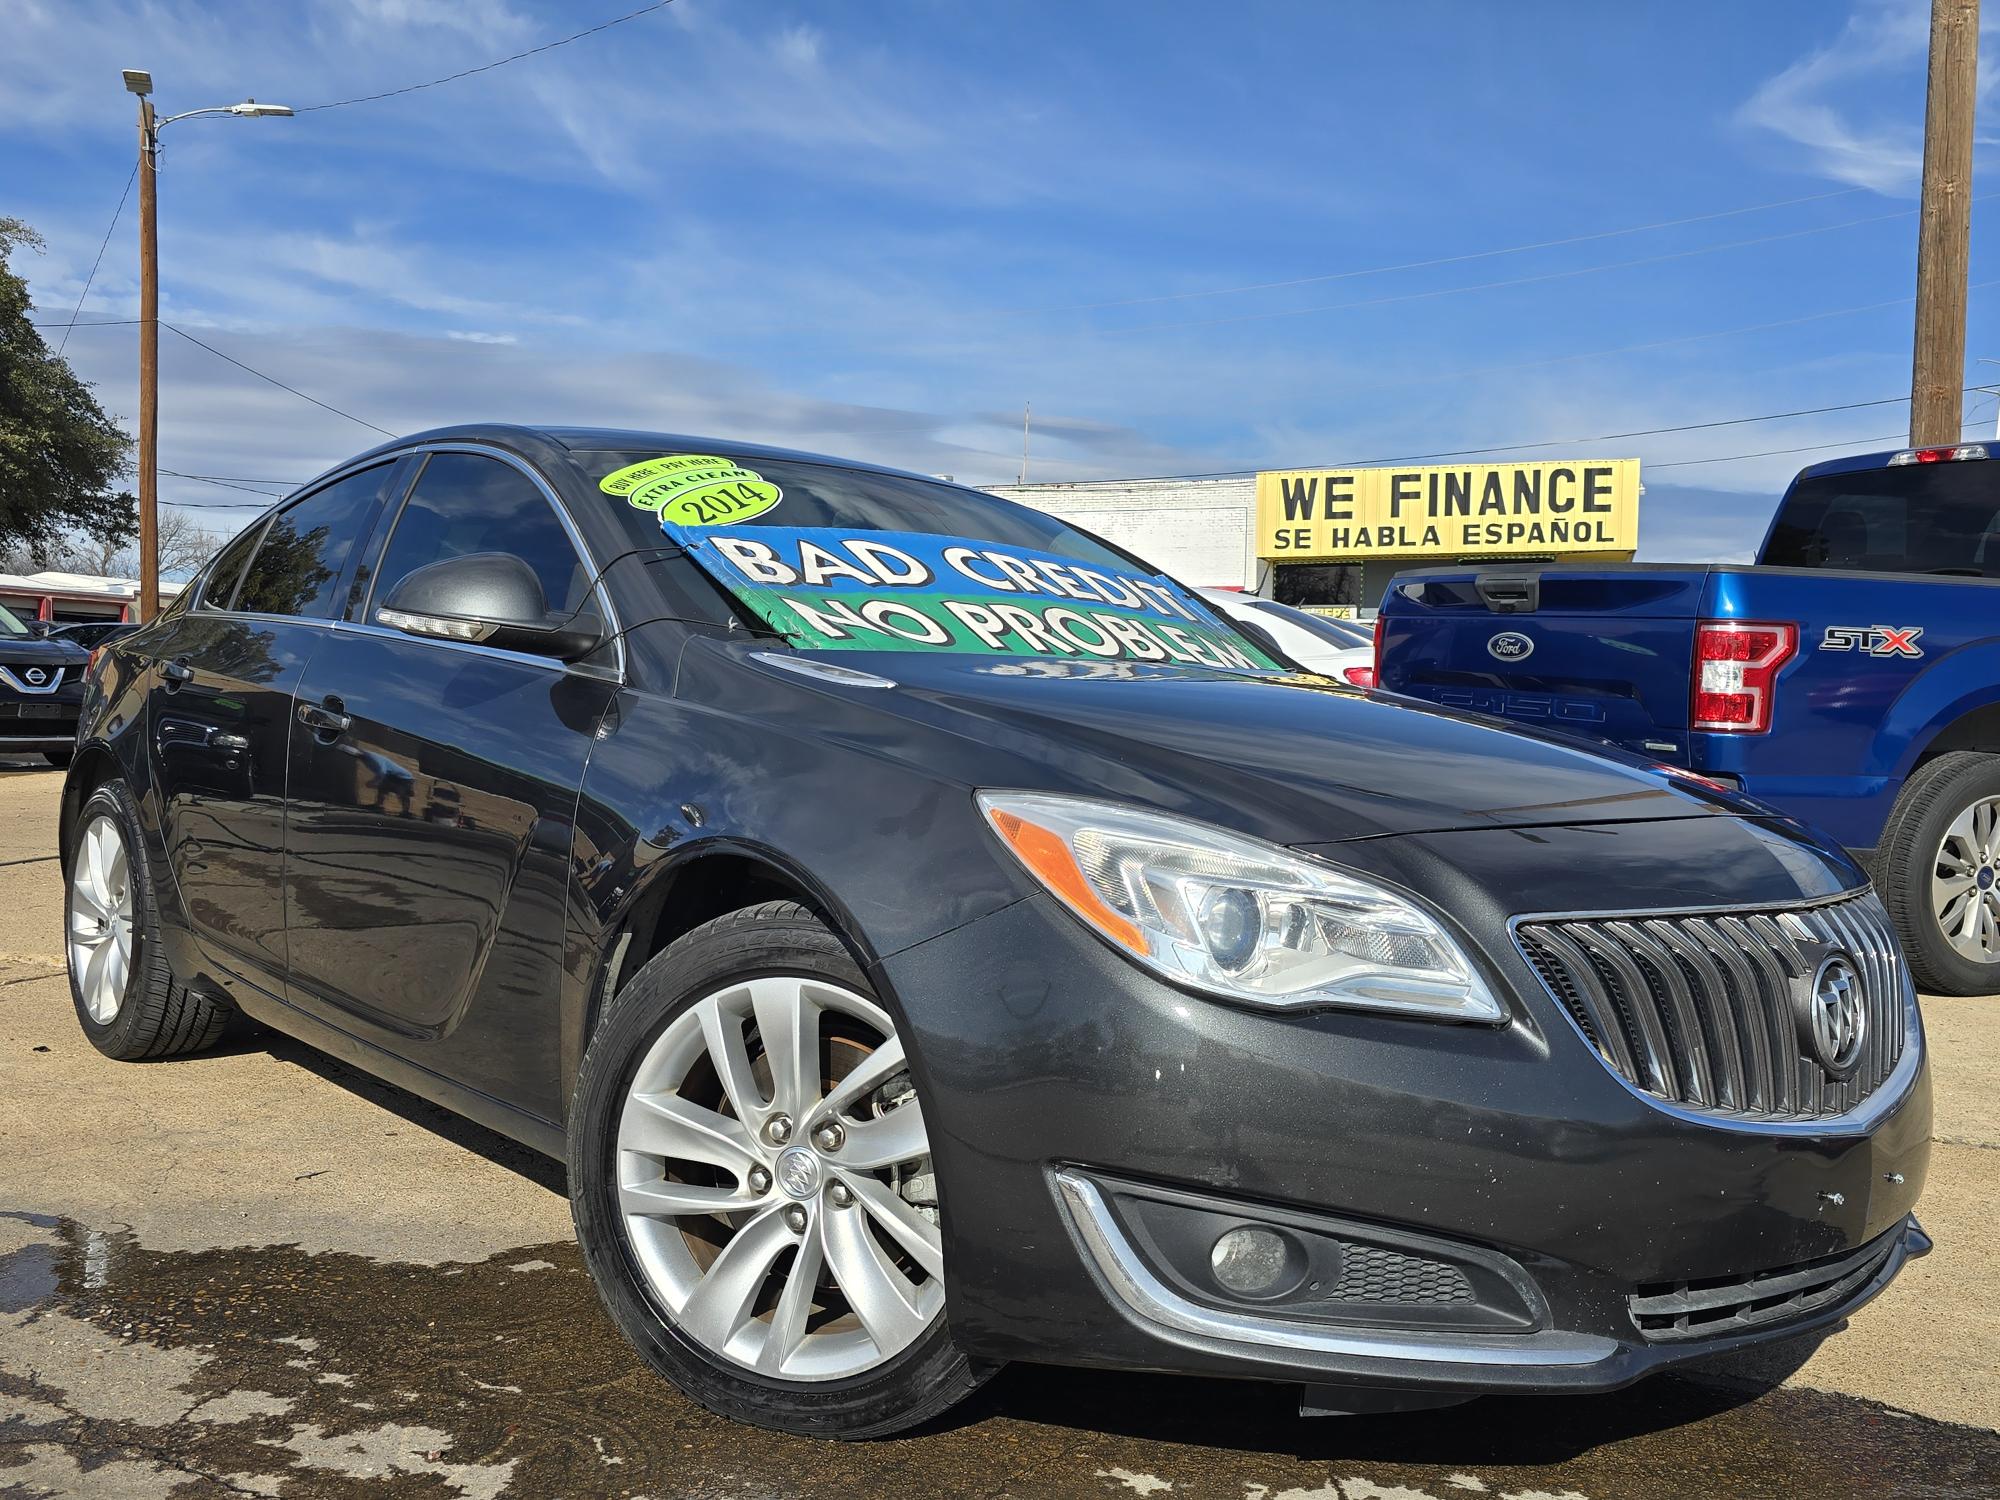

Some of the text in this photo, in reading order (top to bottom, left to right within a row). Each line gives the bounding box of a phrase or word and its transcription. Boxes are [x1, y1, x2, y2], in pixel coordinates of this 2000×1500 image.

[609, 458, 721, 491] BUY HERE PAY HERE
[638, 470, 747, 507] EXTRA CLEAN
[681, 482, 769, 524] 2014
[1281, 467, 1613, 521] WE FINANCE
[1274, 517, 1615, 550] SE HABLA ESPAÑOL
[706, 535, 1199, 622] BAD CREDIT
[780, 599, 1261, 671] NO PROBLEM
[1496, 637, 1521, 654] Ford
[1819, 624, 1925, 659] STX
